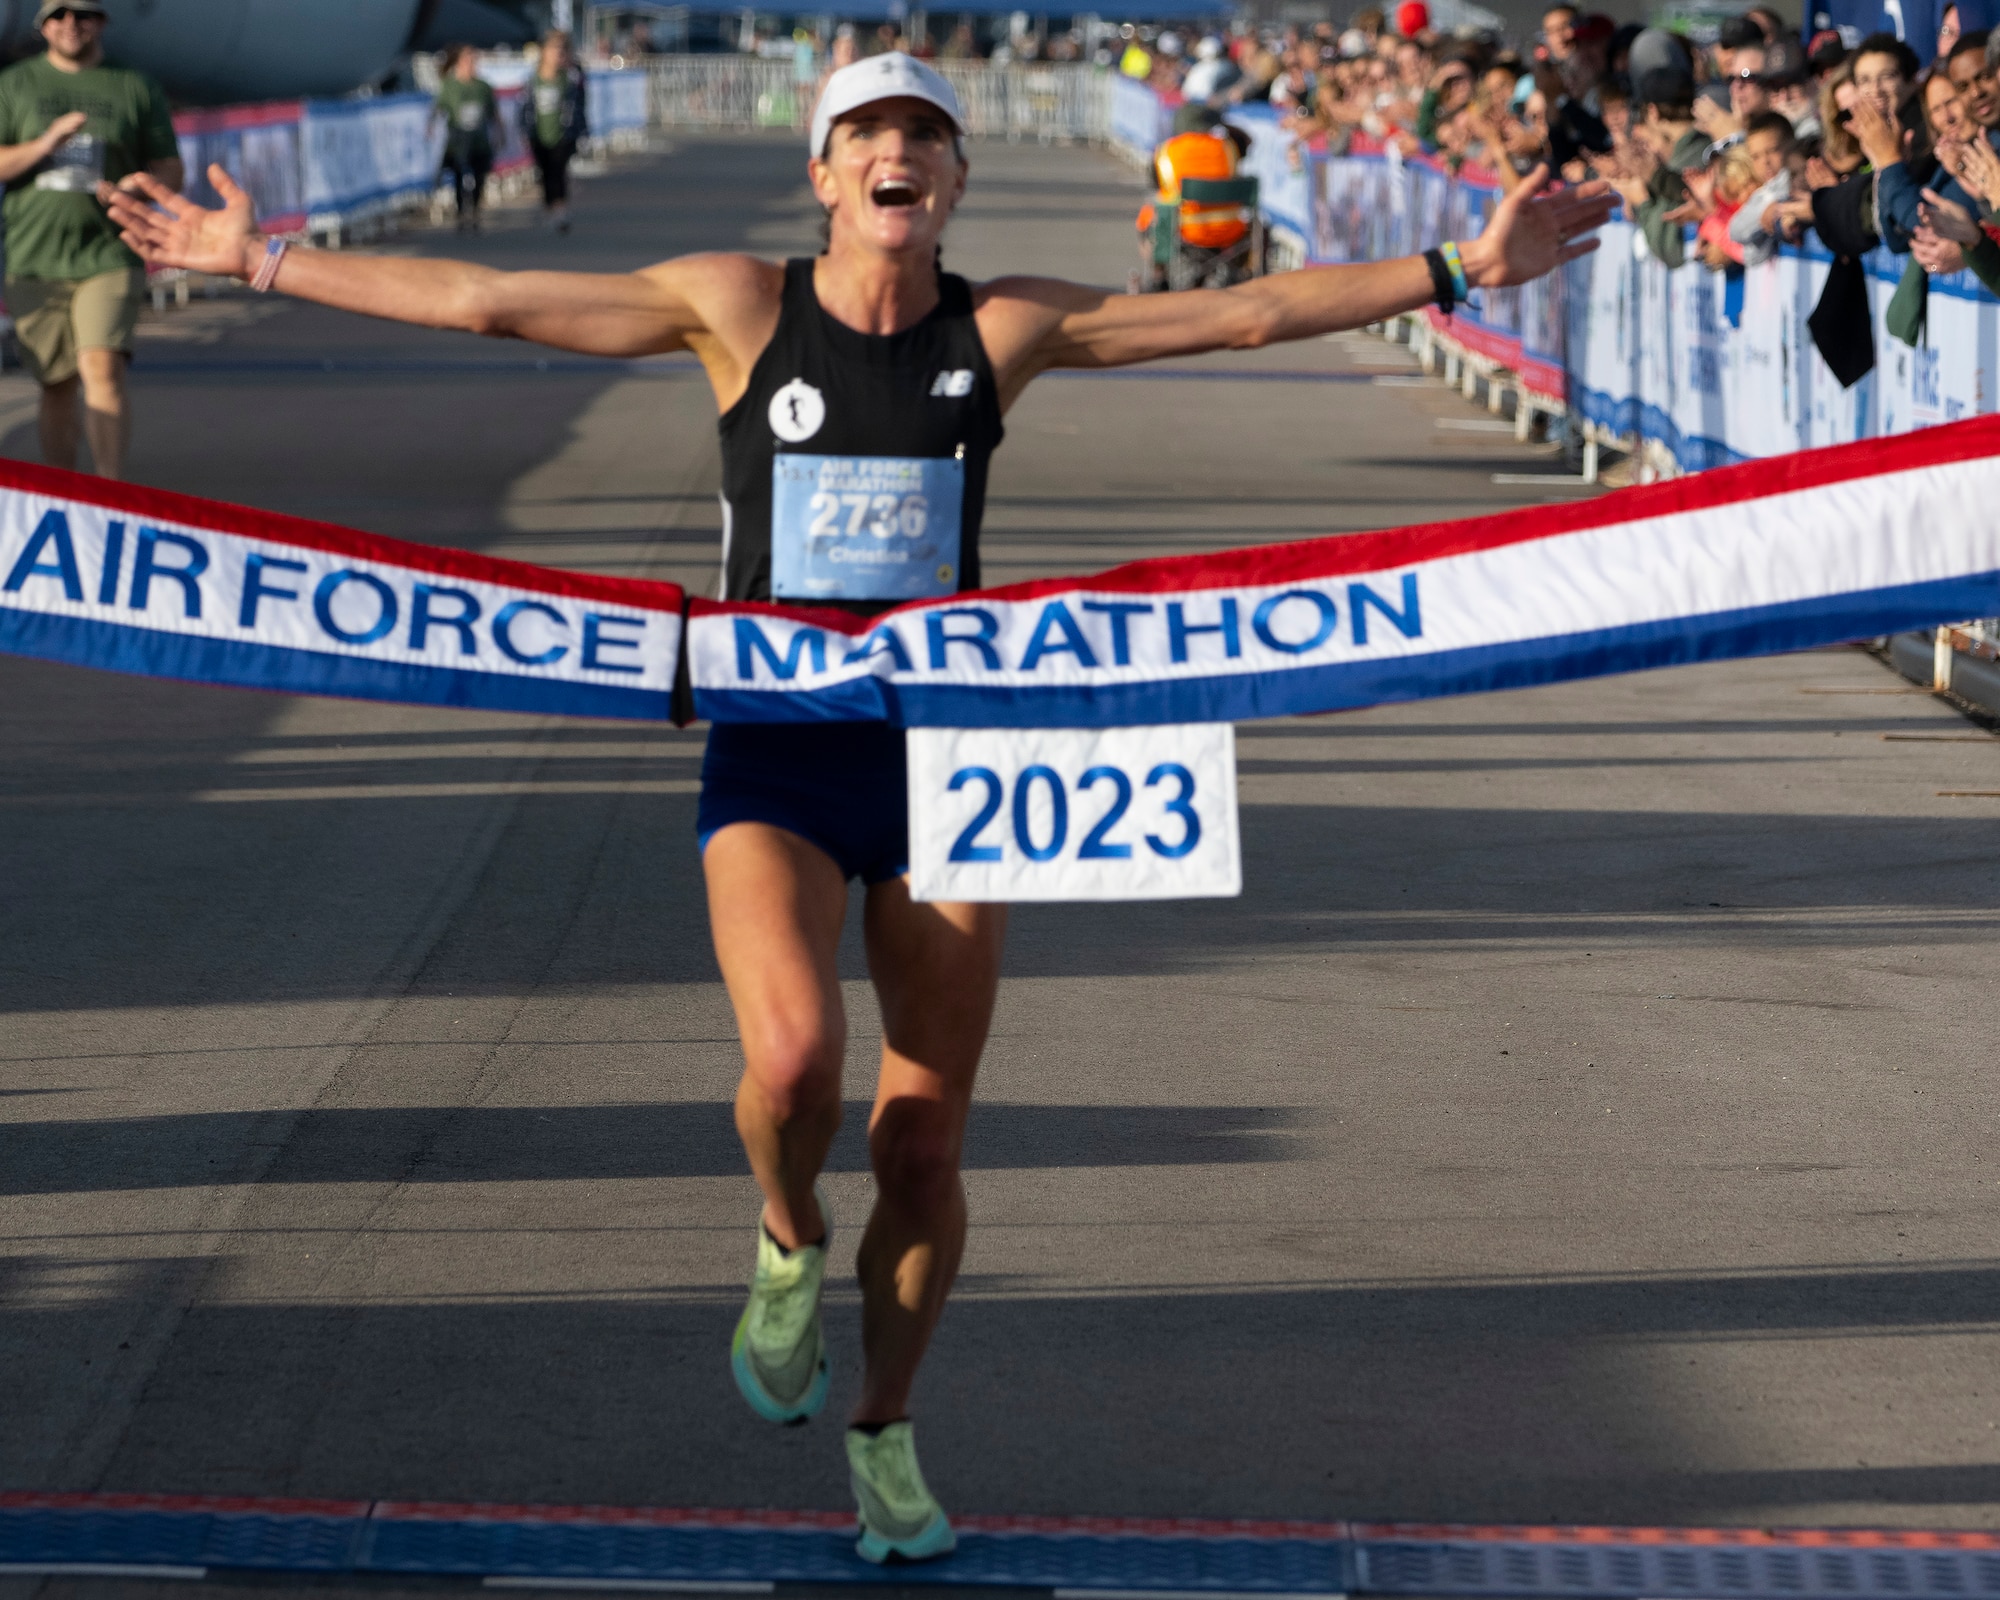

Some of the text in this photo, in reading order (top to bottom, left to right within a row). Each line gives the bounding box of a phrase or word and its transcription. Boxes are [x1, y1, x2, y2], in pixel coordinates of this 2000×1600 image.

[818, 477, 923, 492] MARATHON
[820, 461, 923, 477] AIR FORCE
[809, 492, 928, 539] 2736
[3, 509, 1423, 681] AIR FORCE MARATHON
[947, 762, 1201, 862] 2023
